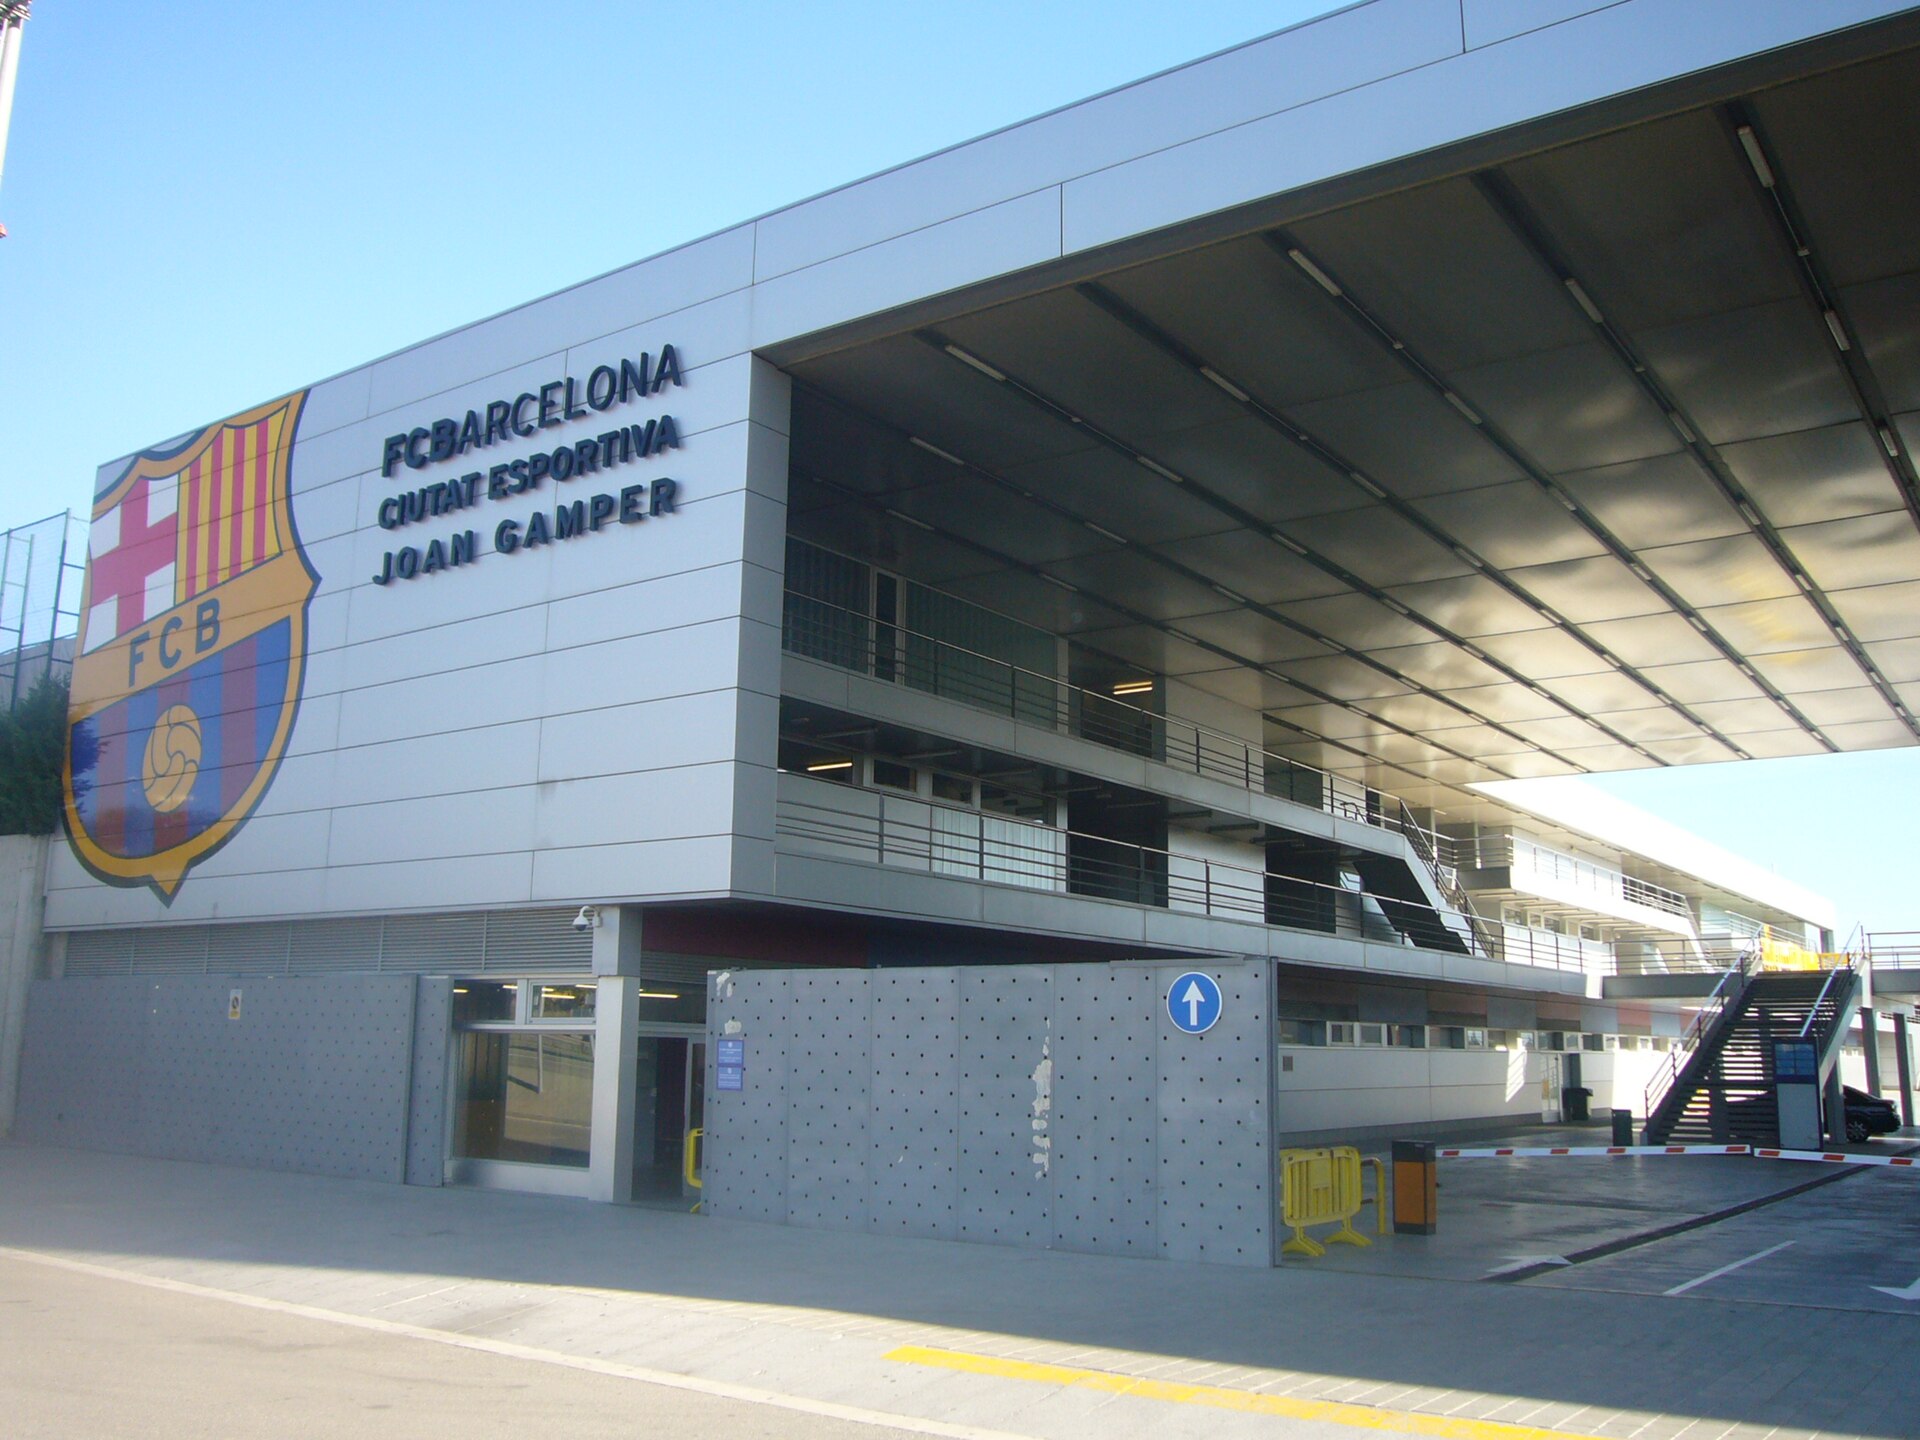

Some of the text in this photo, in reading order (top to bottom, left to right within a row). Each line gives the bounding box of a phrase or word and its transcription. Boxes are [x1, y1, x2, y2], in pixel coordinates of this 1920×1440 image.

[378, 414, 679, 529] CIUTAT ESPORTIVA
[372, 477, 677, 585] JOAN GAMPER
[128, 598, 220, 688] FCB
